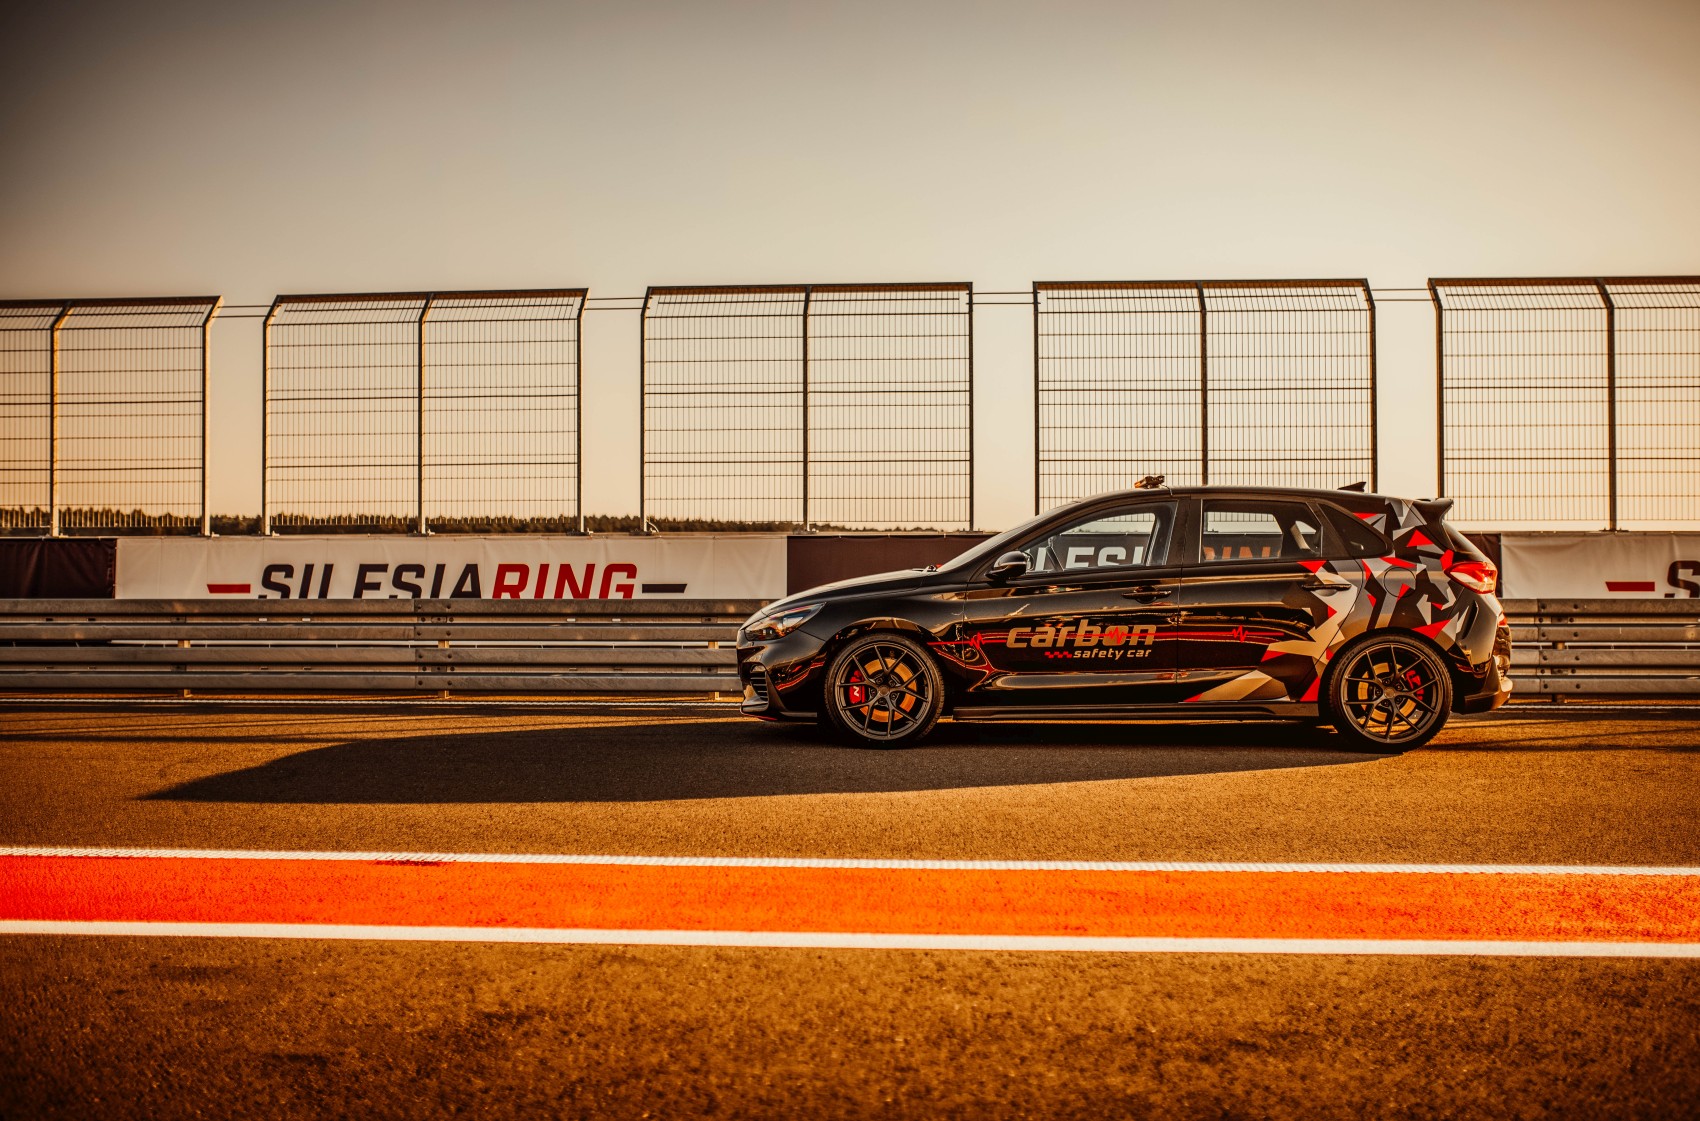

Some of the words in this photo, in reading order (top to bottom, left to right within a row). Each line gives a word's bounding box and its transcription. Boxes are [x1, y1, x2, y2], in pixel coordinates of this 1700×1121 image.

[1006, 619, 1157, 649] carbon
[1073, 648, 1124, 661] safety
[1126, 649, 1152, 659] car
